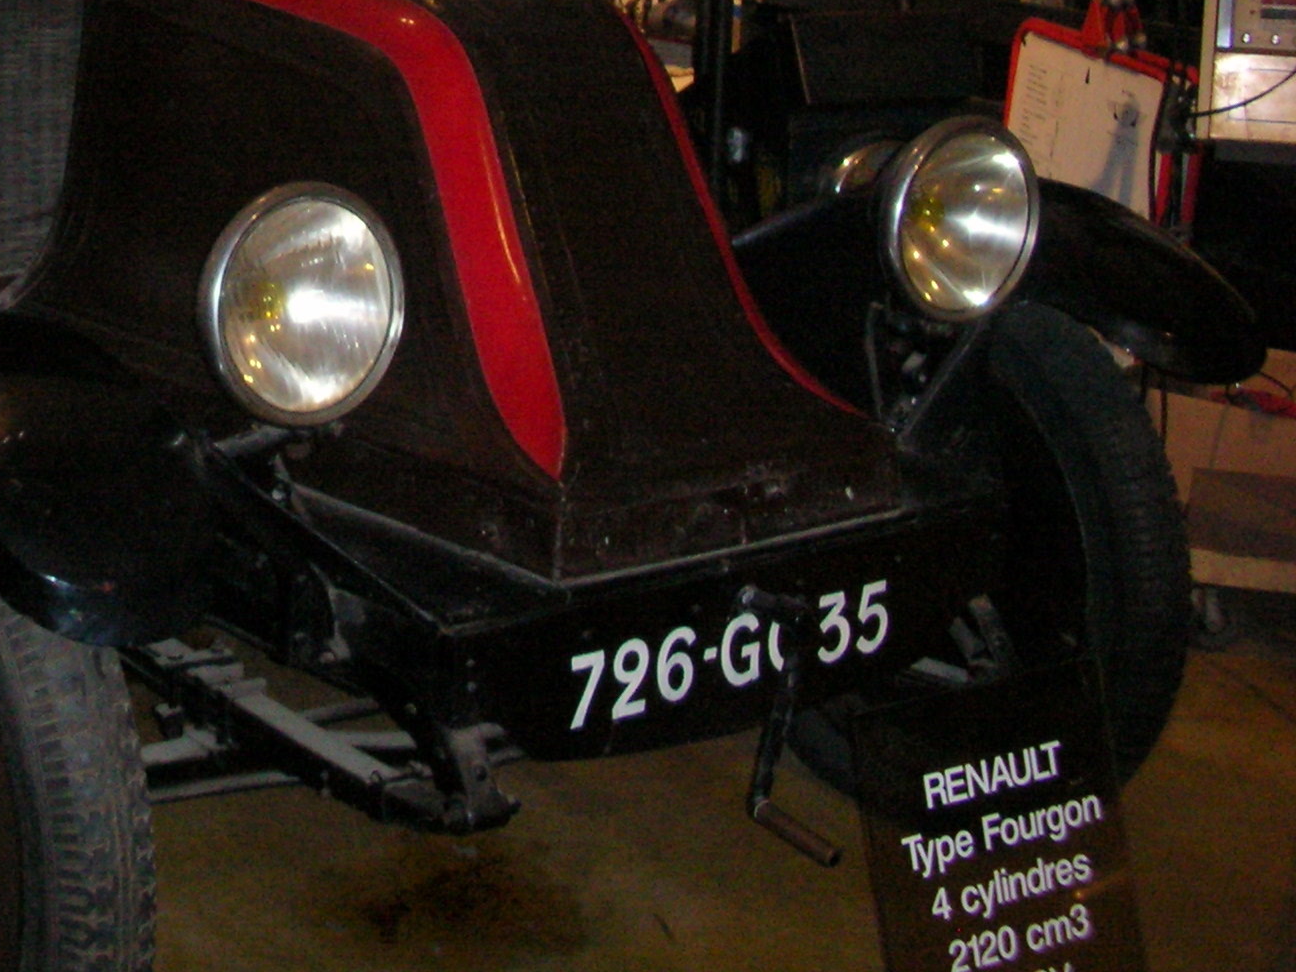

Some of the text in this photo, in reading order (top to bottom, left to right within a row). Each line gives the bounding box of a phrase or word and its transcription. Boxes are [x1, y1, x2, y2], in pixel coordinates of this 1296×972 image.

[816, 580, 890, 664] 35
[923, 739, 1061, 809] RENAULT
[901, 795, 1102, 878] Type Fourgon
[931, 853, 1092, 920] 4 cylindres
[948, 903, 1090, 972] 2120 cm3
